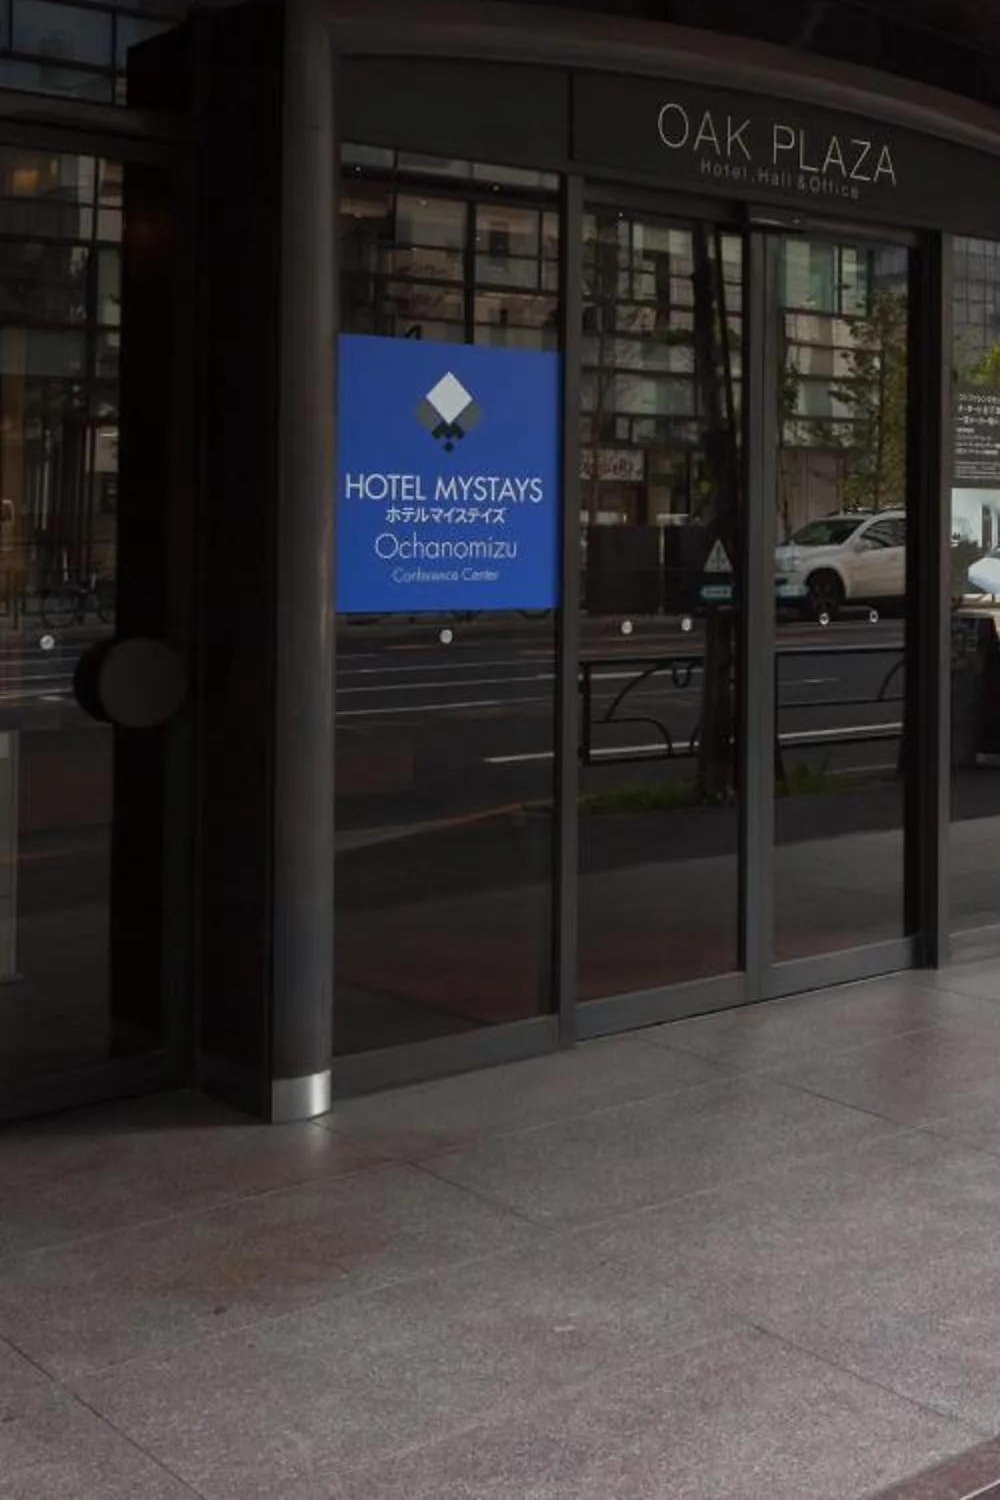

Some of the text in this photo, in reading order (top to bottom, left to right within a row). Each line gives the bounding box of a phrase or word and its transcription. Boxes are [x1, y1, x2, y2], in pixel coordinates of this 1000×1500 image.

[658, 103, 897, 187] OAK PLAZA
[345, 473, 543, 503] HOTEL MYSTAYS
[385, 507, 507, 523] ホテルマイステイズ
[375, 532, 518, 559] Ochanomizu
